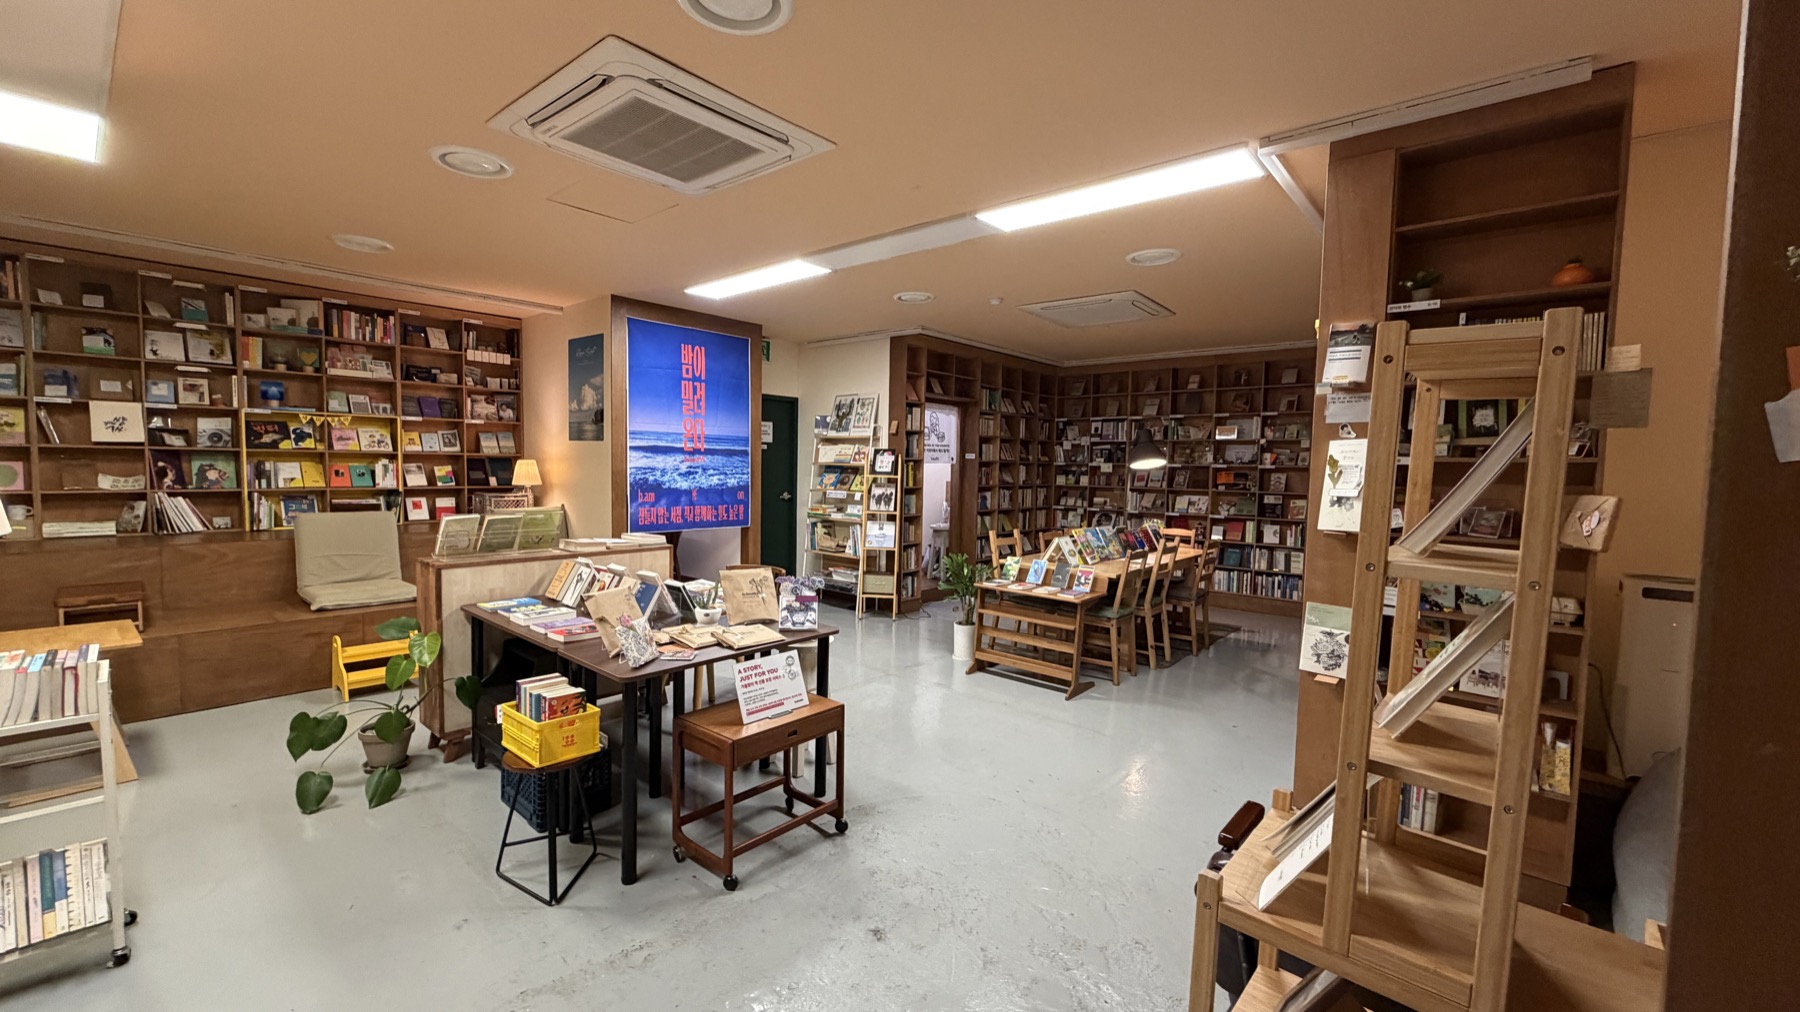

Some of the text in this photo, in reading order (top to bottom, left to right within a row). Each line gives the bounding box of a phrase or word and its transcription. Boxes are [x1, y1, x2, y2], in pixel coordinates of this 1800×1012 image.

[681, 344, 706, 380] 밤이
[681, 381, 706, 416] 밀려
[683, 417, 706, 452] 온다
[638, 489, 655, 502] b.am
[638, 506, 656, 525] 잠들지
[657, 506, 669, 524] 않는
[695, 504, 717, 522] 함께하는
[729, 504, 739, 521] 높은
[740, 674, 753, 682] JUST
[754, 671, 766, 679] FOR
[743, 664, 763, 673] STORY,
